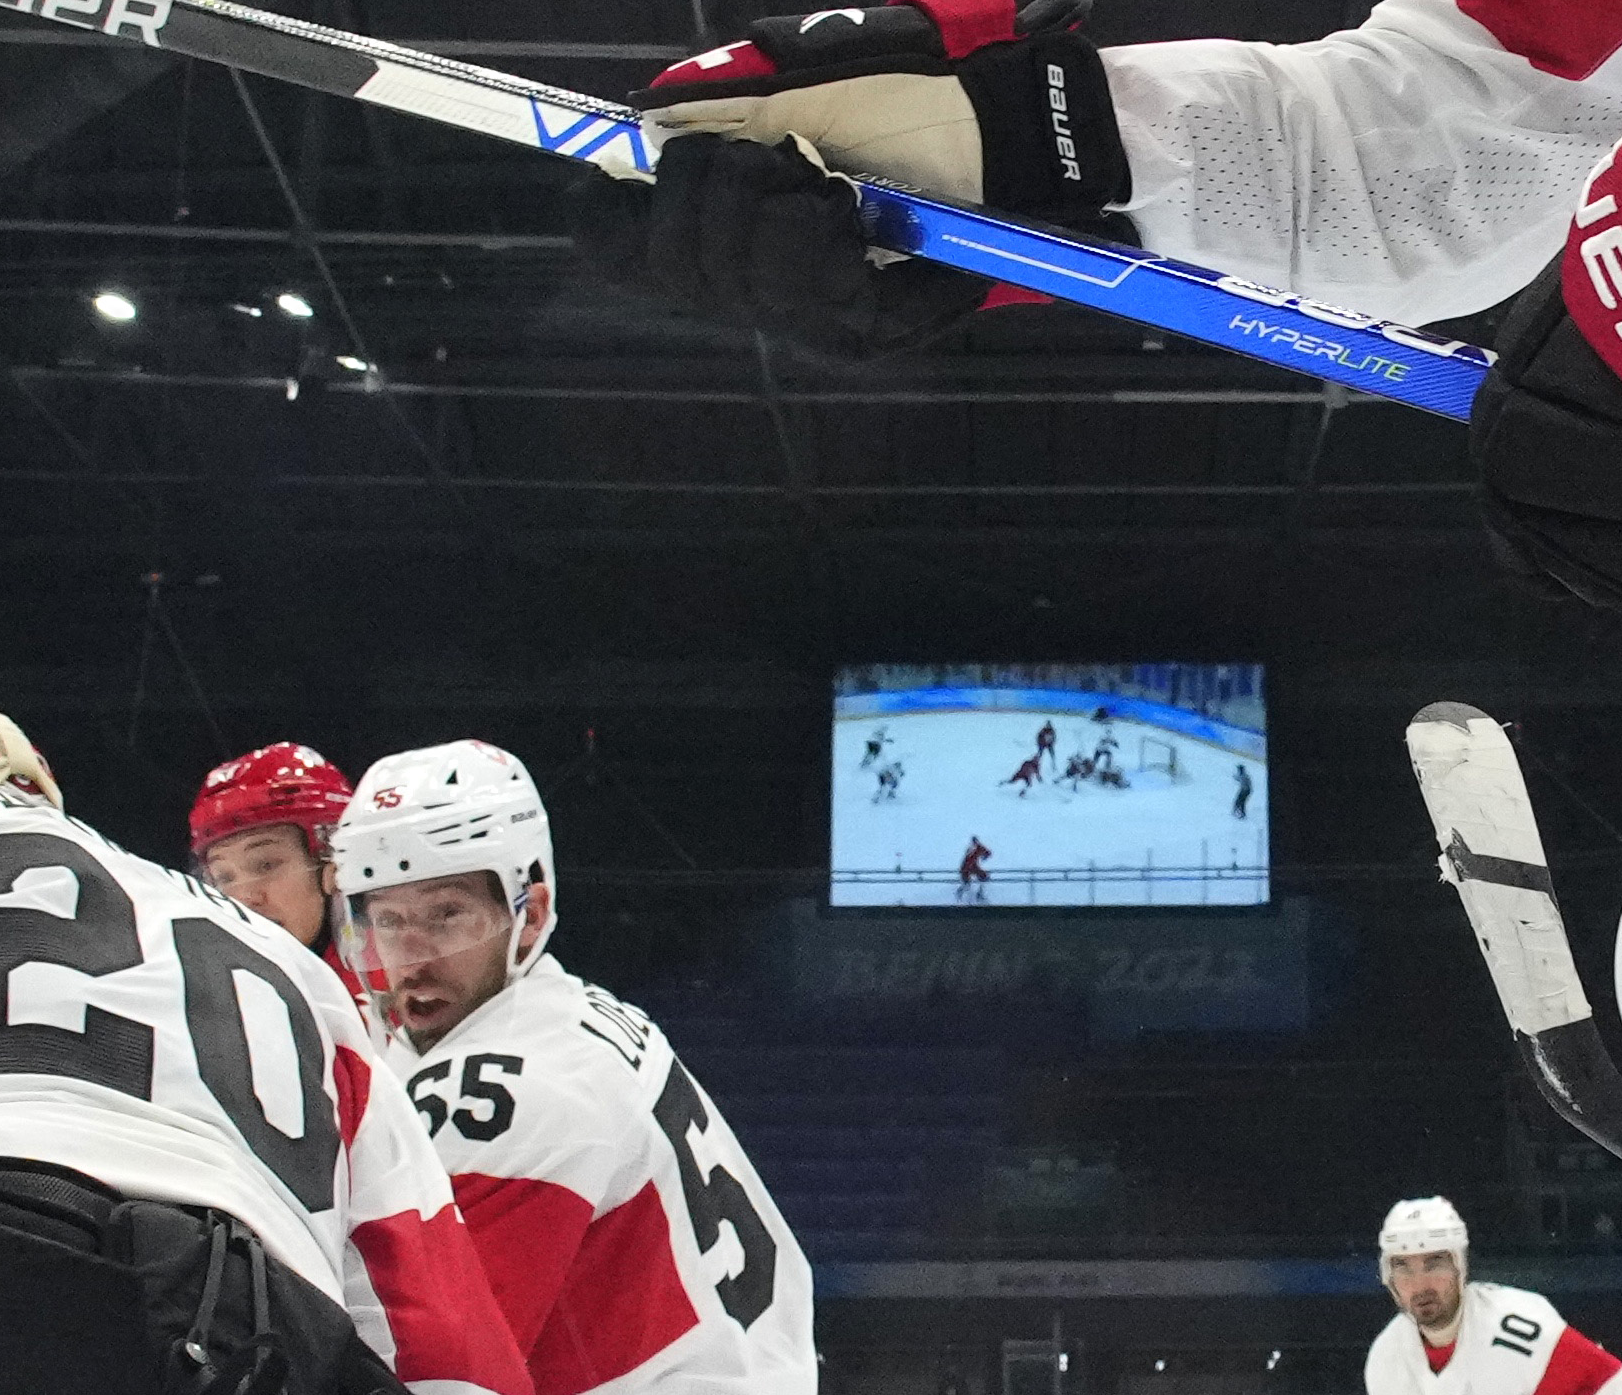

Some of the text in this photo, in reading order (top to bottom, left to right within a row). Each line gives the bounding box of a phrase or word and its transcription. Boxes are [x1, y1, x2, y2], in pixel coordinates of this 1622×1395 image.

[1046, 64, 1082, 182] BAUER
[1228, 313, 1411, 383] HYPERLITE
[1491, 1311, 1543, 1359] 10
